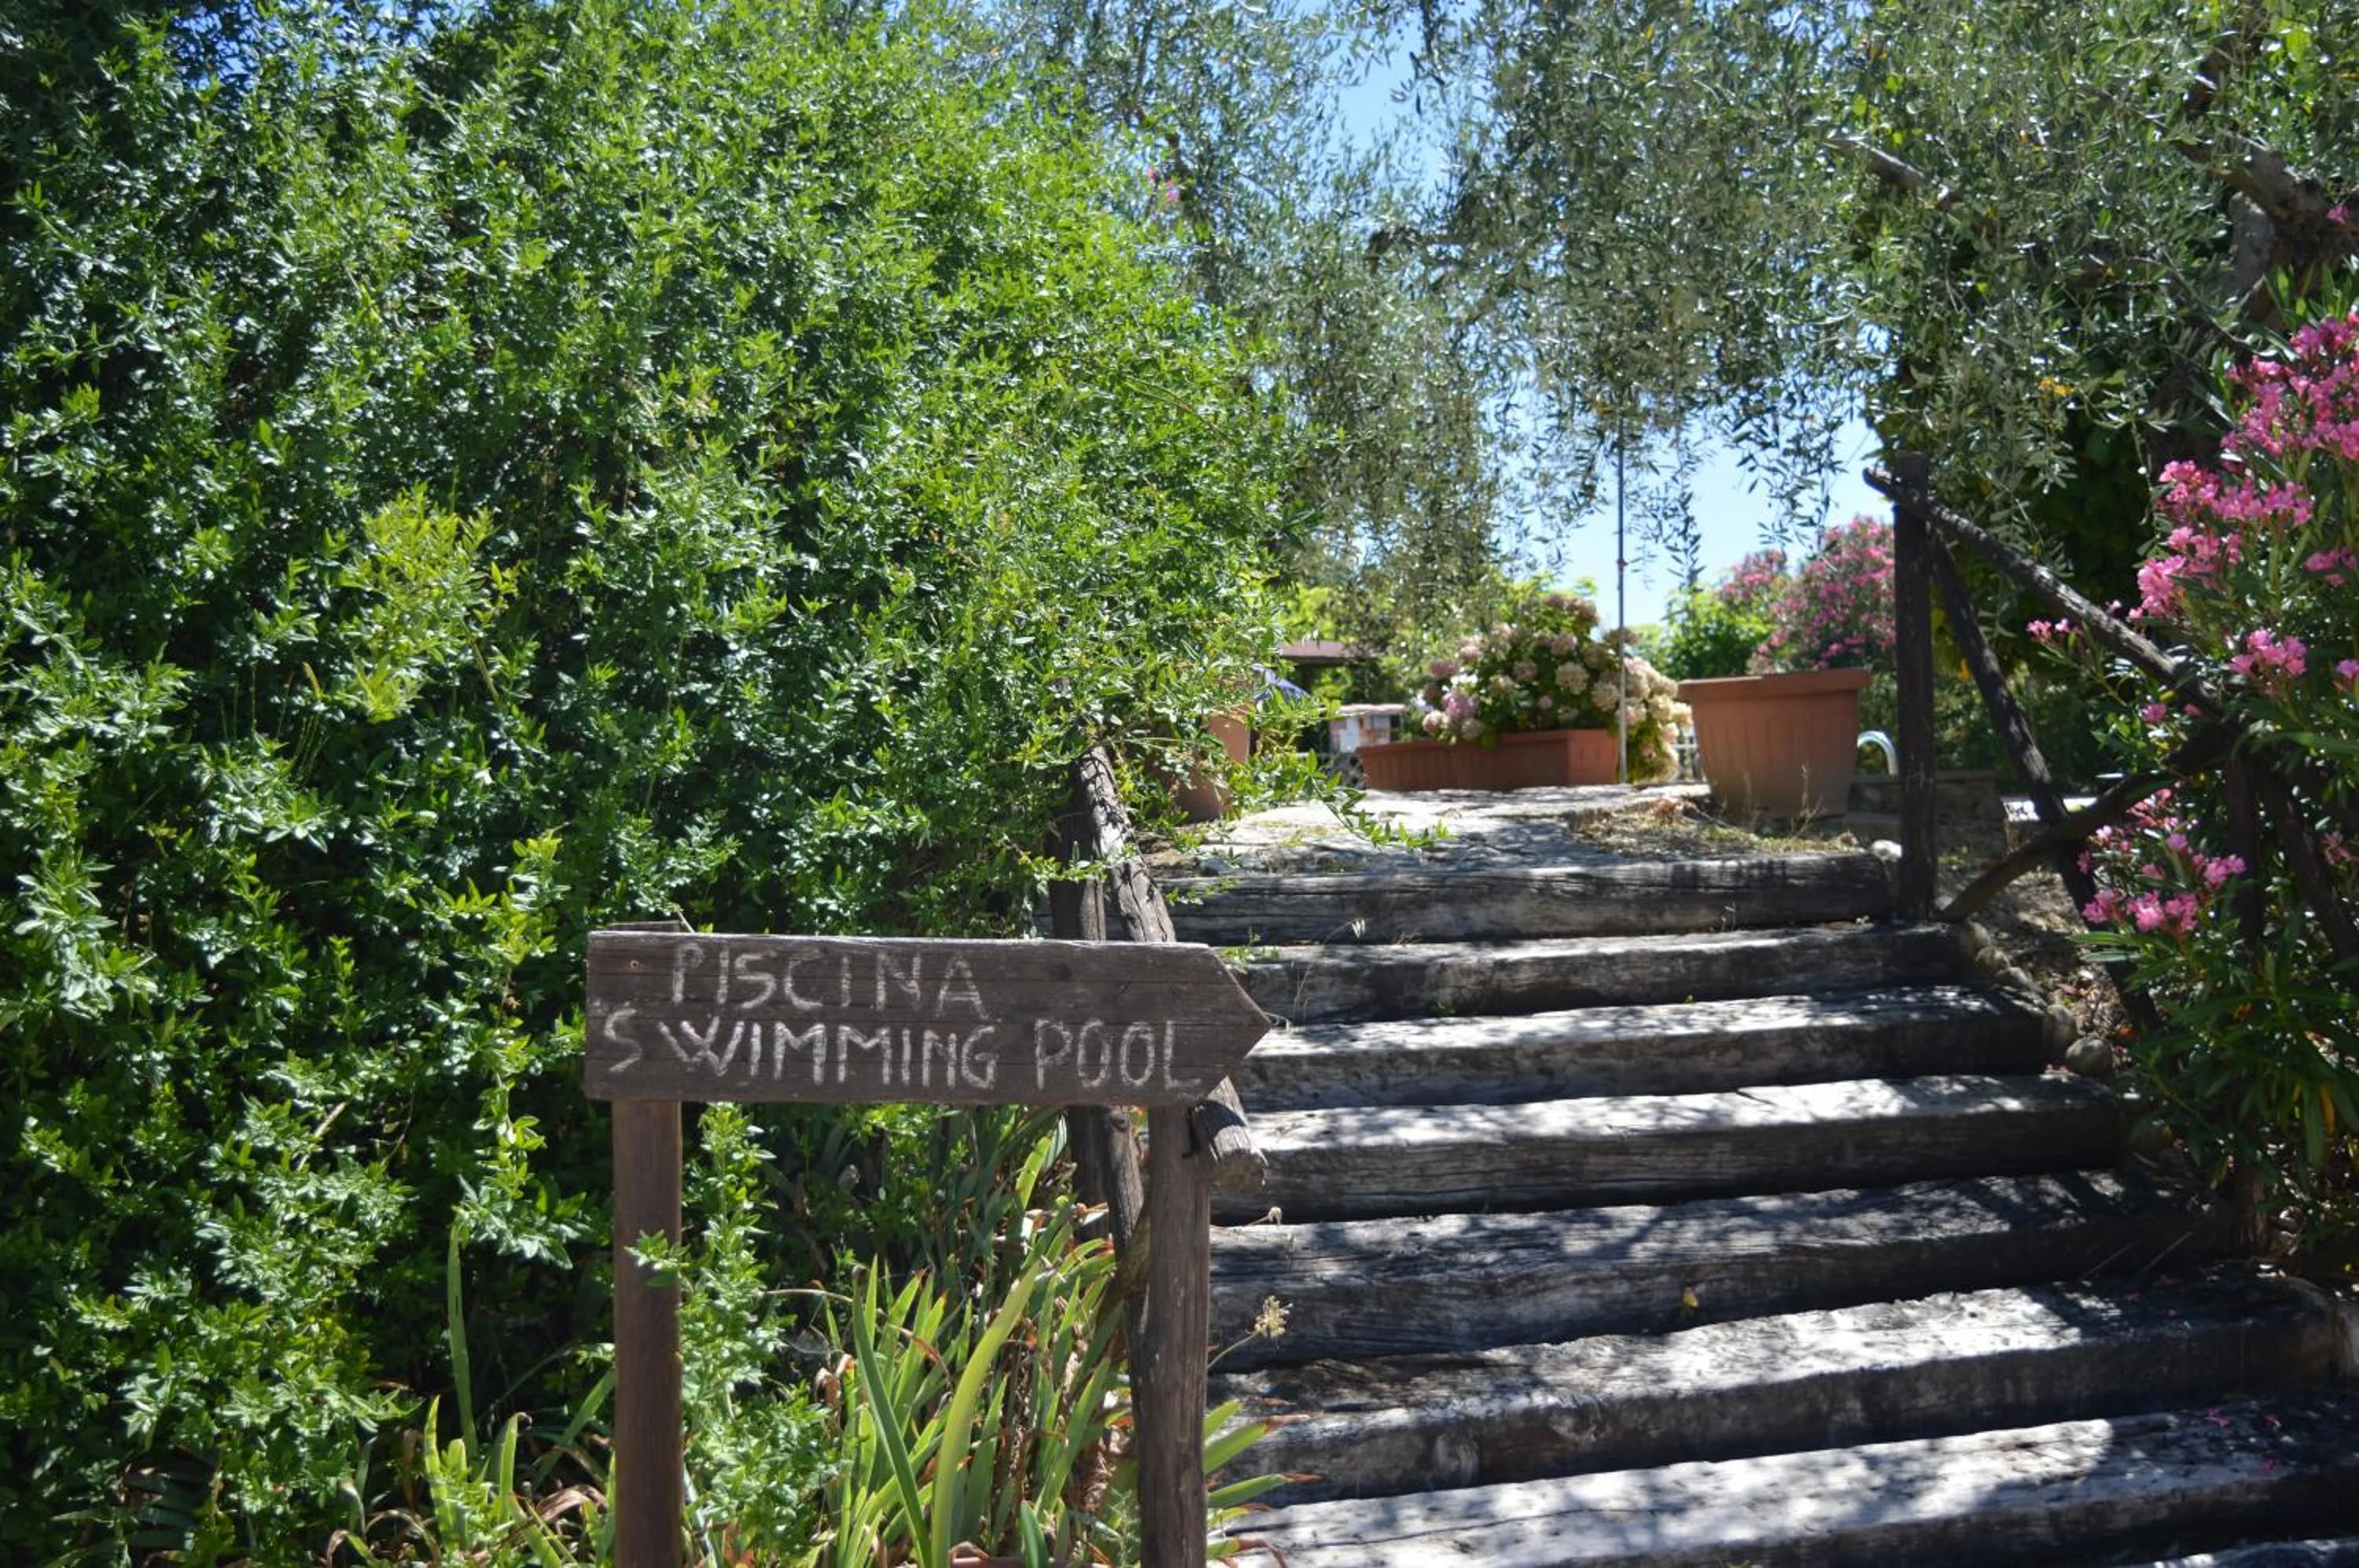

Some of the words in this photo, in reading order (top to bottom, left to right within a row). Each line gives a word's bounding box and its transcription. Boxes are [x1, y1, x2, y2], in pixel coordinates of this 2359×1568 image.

[671, 943, 988, 1020] PISCINA
[603, 1007, 997, 1090] SWIMMING
[1034, 1018, 1203, 1091] POOL
